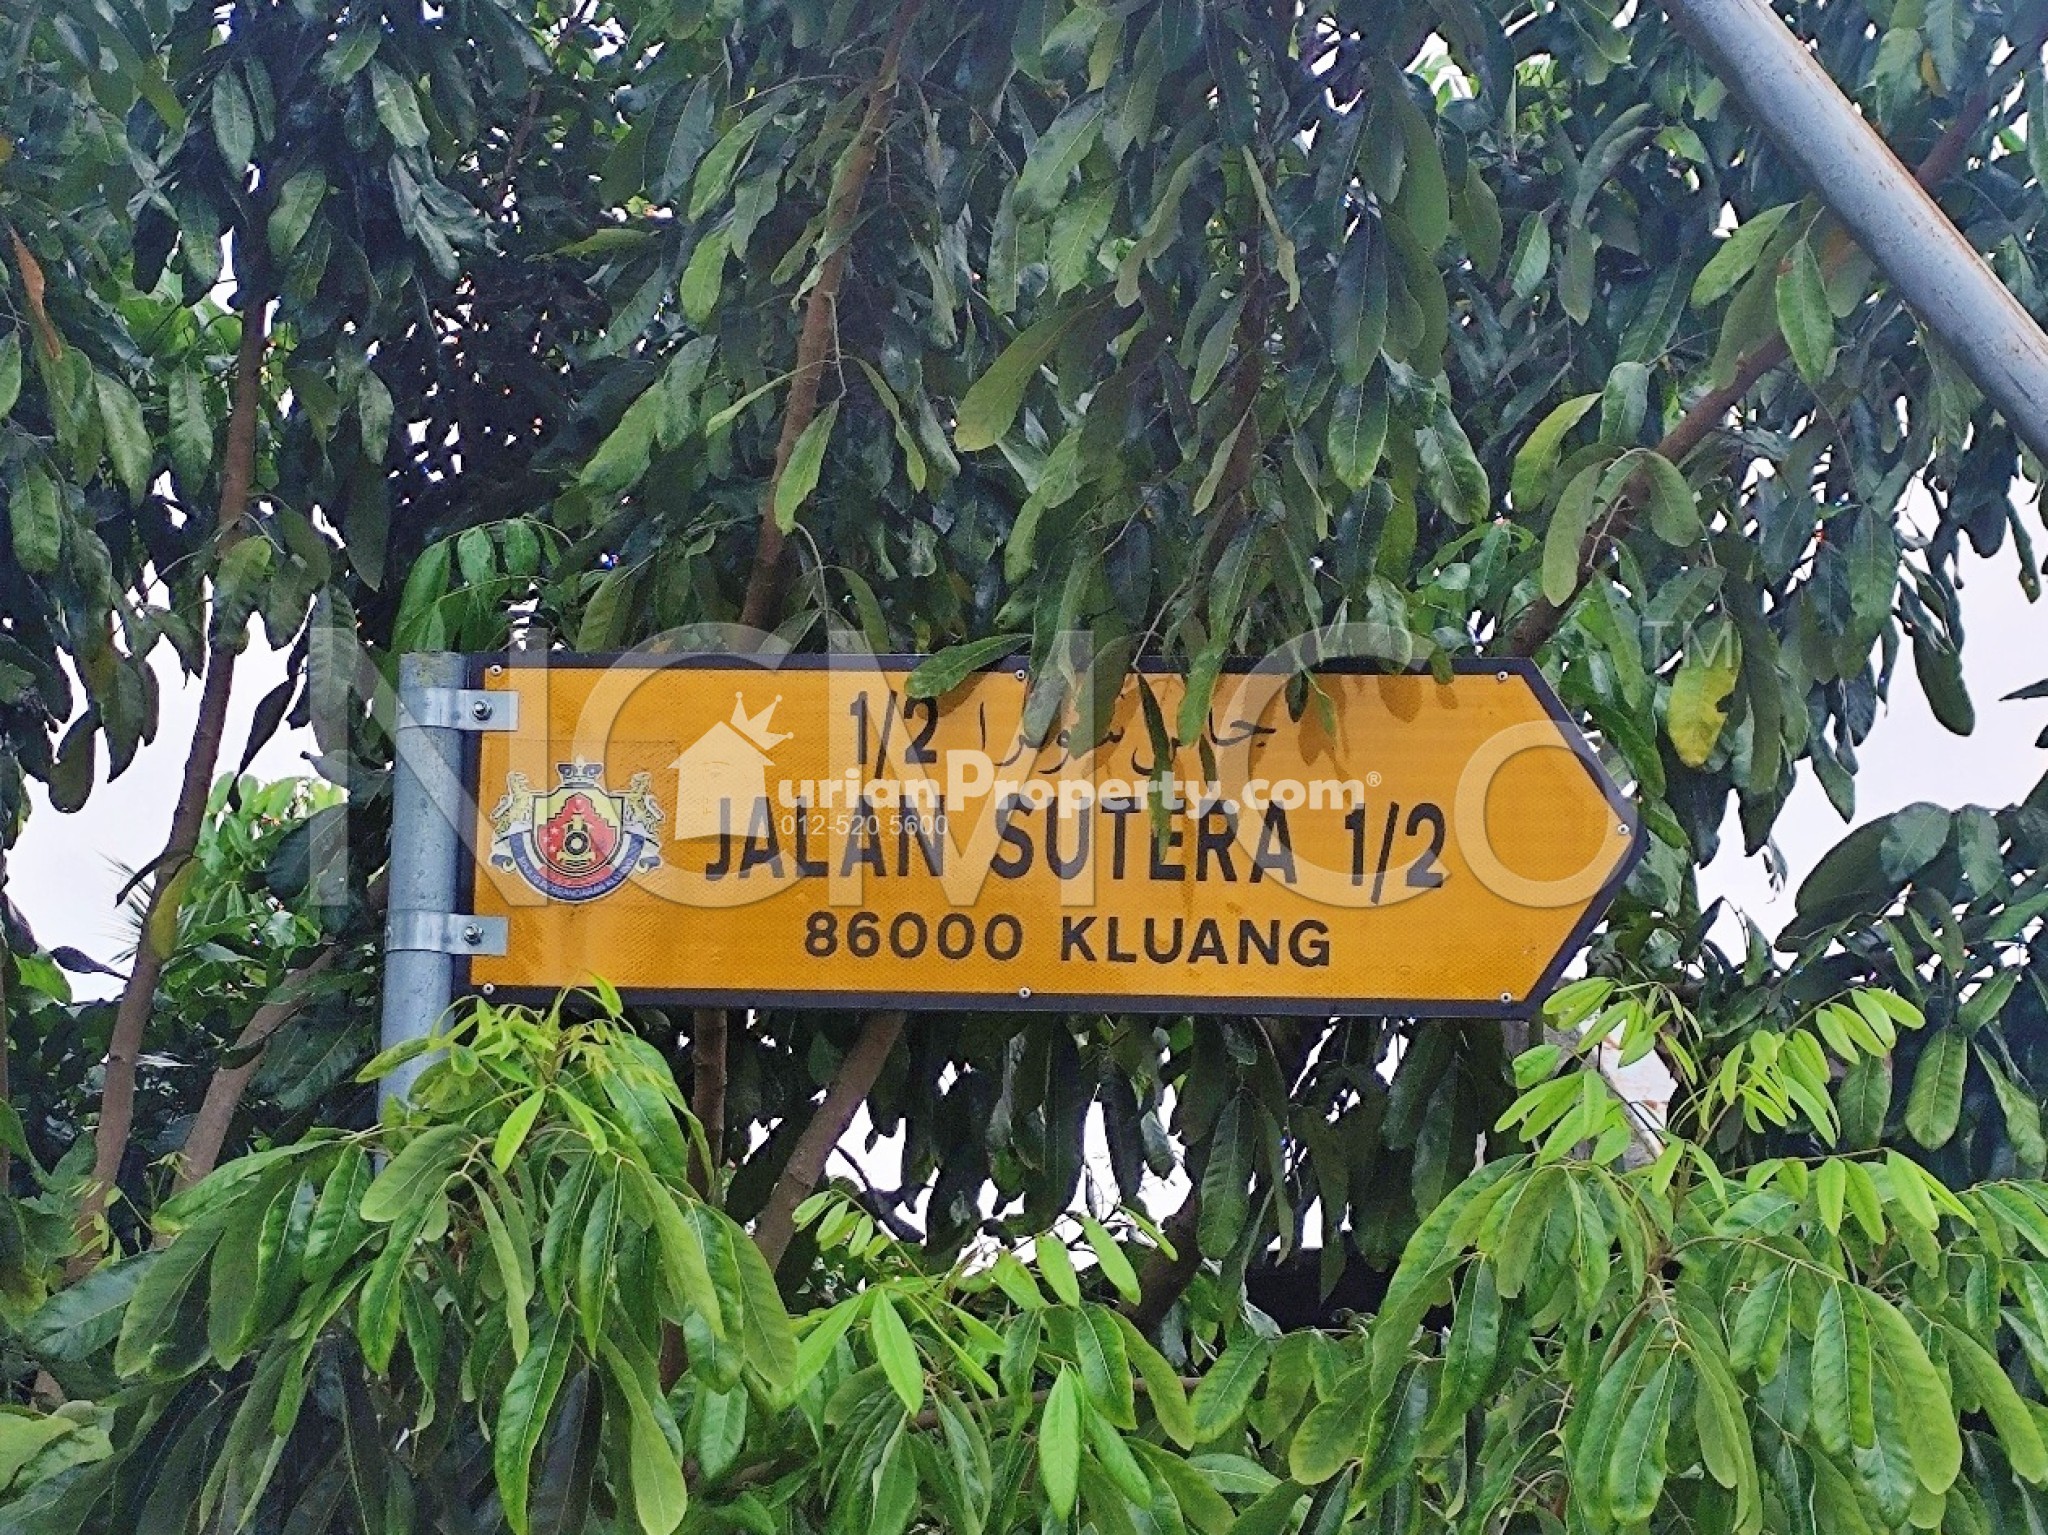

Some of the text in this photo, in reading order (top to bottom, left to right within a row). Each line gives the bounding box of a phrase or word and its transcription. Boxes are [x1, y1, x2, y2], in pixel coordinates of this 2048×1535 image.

[849, 690, 938, 780] 1/2
[705, 792, 1447, 906] JALAN SUTERA 1/2
[804, 911, 1331, 968] 86000 KLUANG
